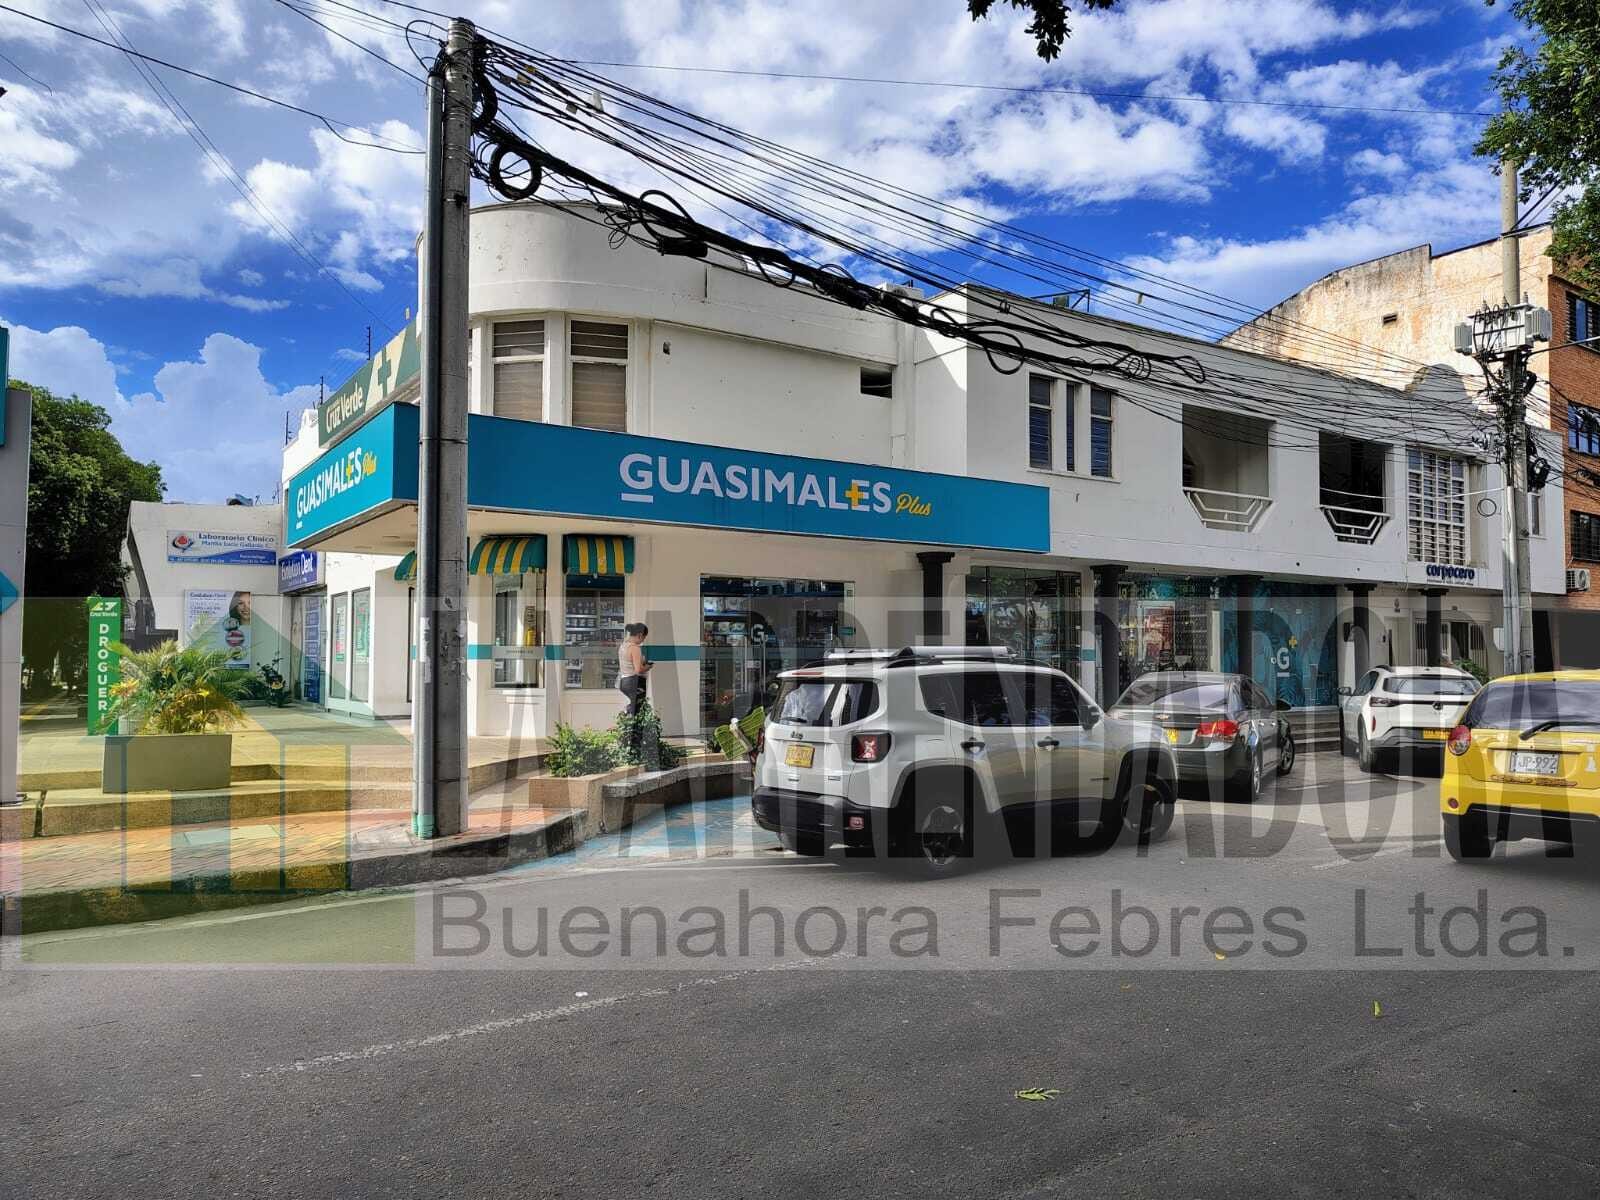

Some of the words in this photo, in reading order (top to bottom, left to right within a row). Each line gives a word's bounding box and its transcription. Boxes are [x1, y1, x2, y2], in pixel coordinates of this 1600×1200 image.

[326, 402, 341, 433] Cruz
[340, 382, 364, 420] Verde
[296, 447, 362, 520] GUASIMALES
[619, 453, 892, 514] GUASIMALES
[896, 493, 933, 517] Plus
[198, 533, 245, 542] Laboratorio
[97, 624, 110, 725] DROGUERI
